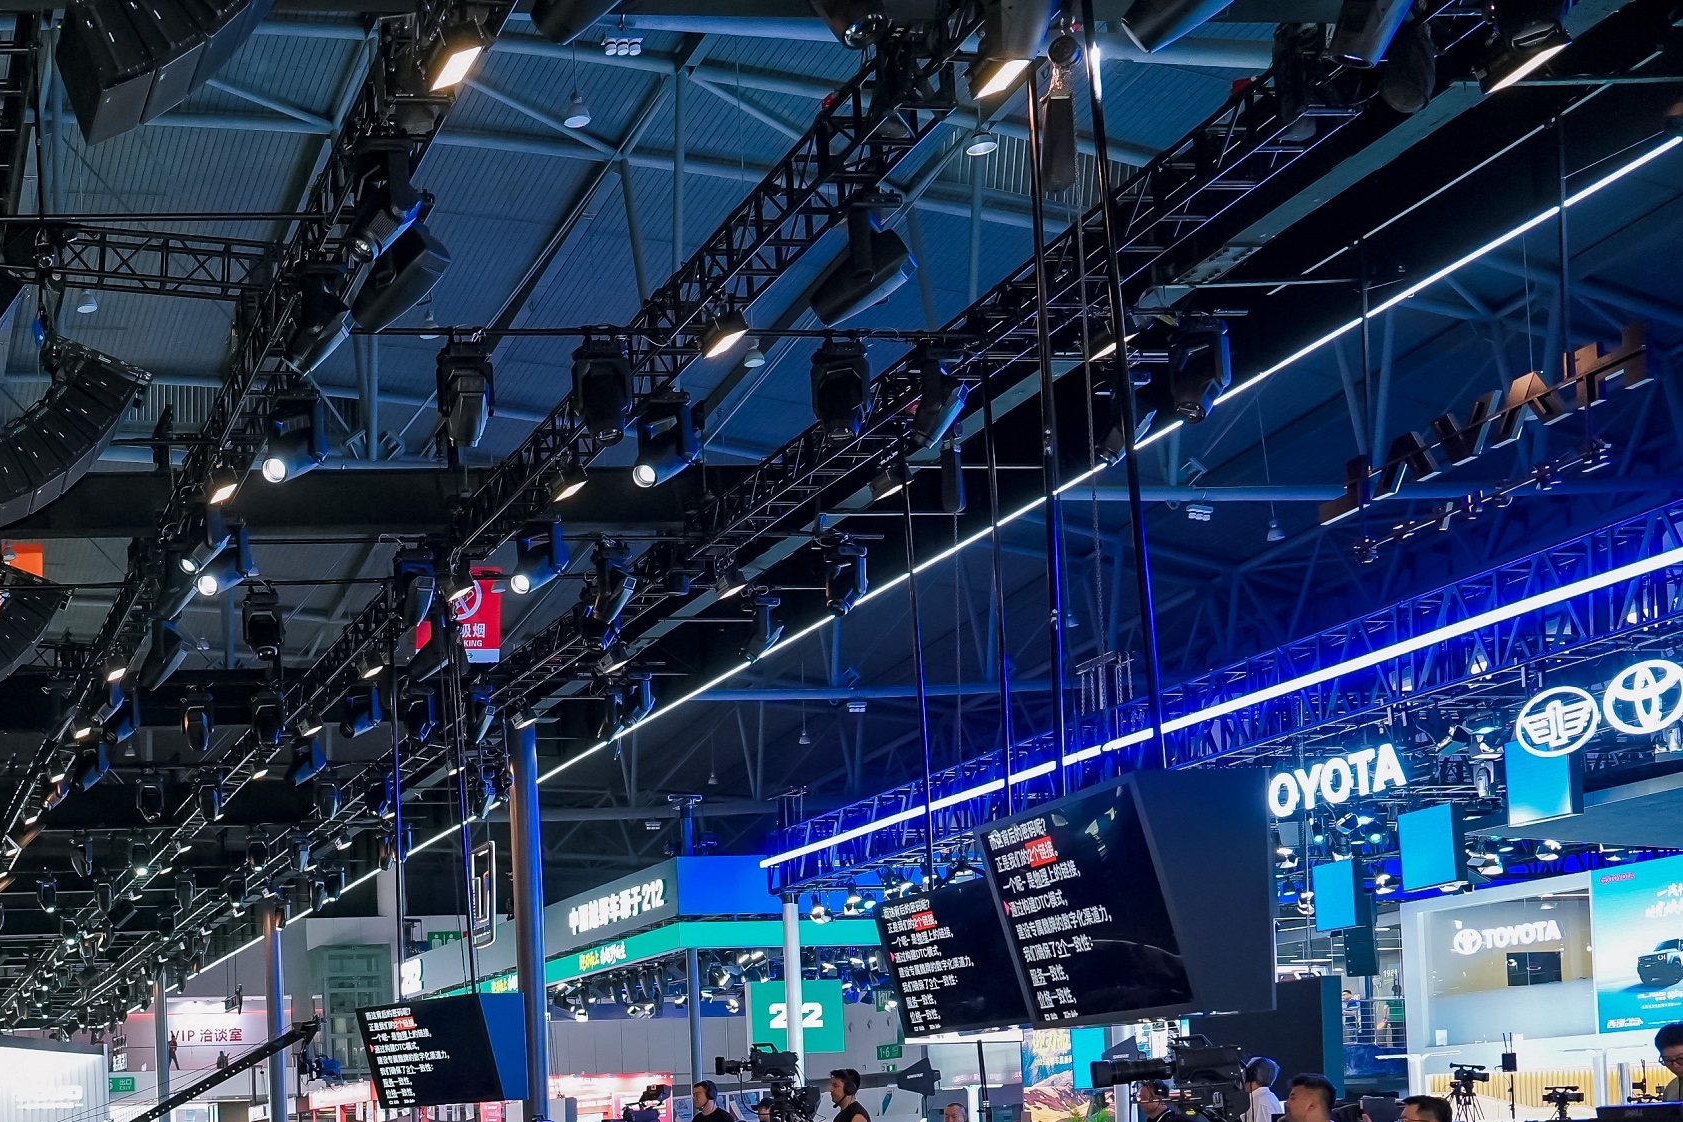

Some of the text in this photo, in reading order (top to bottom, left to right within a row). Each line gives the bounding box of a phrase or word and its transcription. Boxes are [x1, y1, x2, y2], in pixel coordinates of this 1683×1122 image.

[460, 623, 485, 638] 吸烟
[1269, 743, 1407, 818] OYOTA
[1482, 919, 1562, 949] TOYOTA
[769, 1002, 824, 1029] 22
[170, 1028, 243, 1042] VIP 洽谈室
